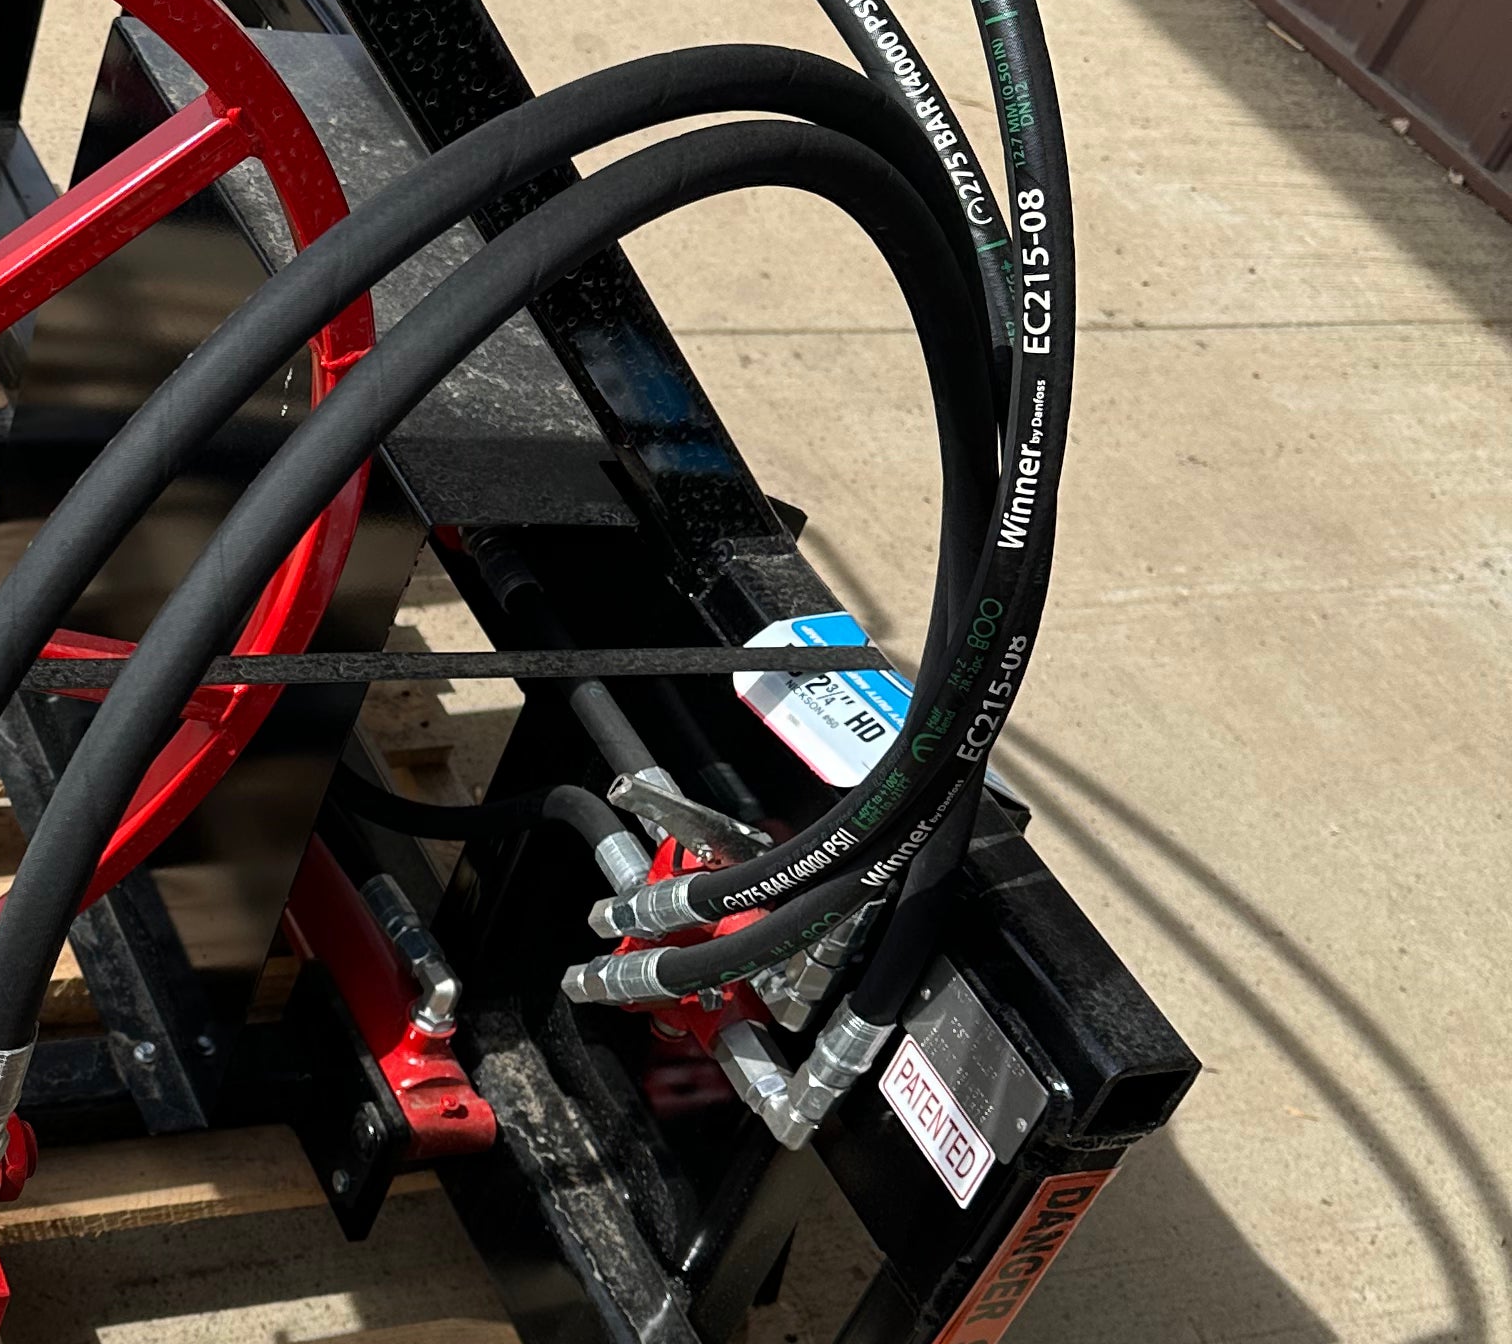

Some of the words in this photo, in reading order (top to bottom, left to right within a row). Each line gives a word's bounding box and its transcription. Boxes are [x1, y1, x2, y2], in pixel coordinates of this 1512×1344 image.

[876, 31, 931, 100] (4000
[992, 36, 1008, 63] IN)
[997, 62, 1018, 102] (0.50
[1014, 80, 1035, 130] DN12
[916, 91, 961, 150] BAR
[1007, 104, 1023, 136] MM
[942, 153, 987, 206] 275
[1011, 138, 1026, 171] 12.7
[1017, 187, 1053, 356] EC215-08
[1030, 378, 1048, 429] Danfoss
[1029, 427, 1045, 446] by
[997, 442, 1044, 551] Winner
[967, 598, 1005, 651] 800
[785, 679, 825, 716] NICKSON
[843, 710, 887, 744] HD
[734, 884, 765, 911] 275
[762, 873, 794, 899] BAR
[789, 849, 831, 886] (4000
[860, 818, 932, 890] Winner
[893, 1053, 978, 1182] PATENTED
[965, 1183, 1097, 1324] DANGER
